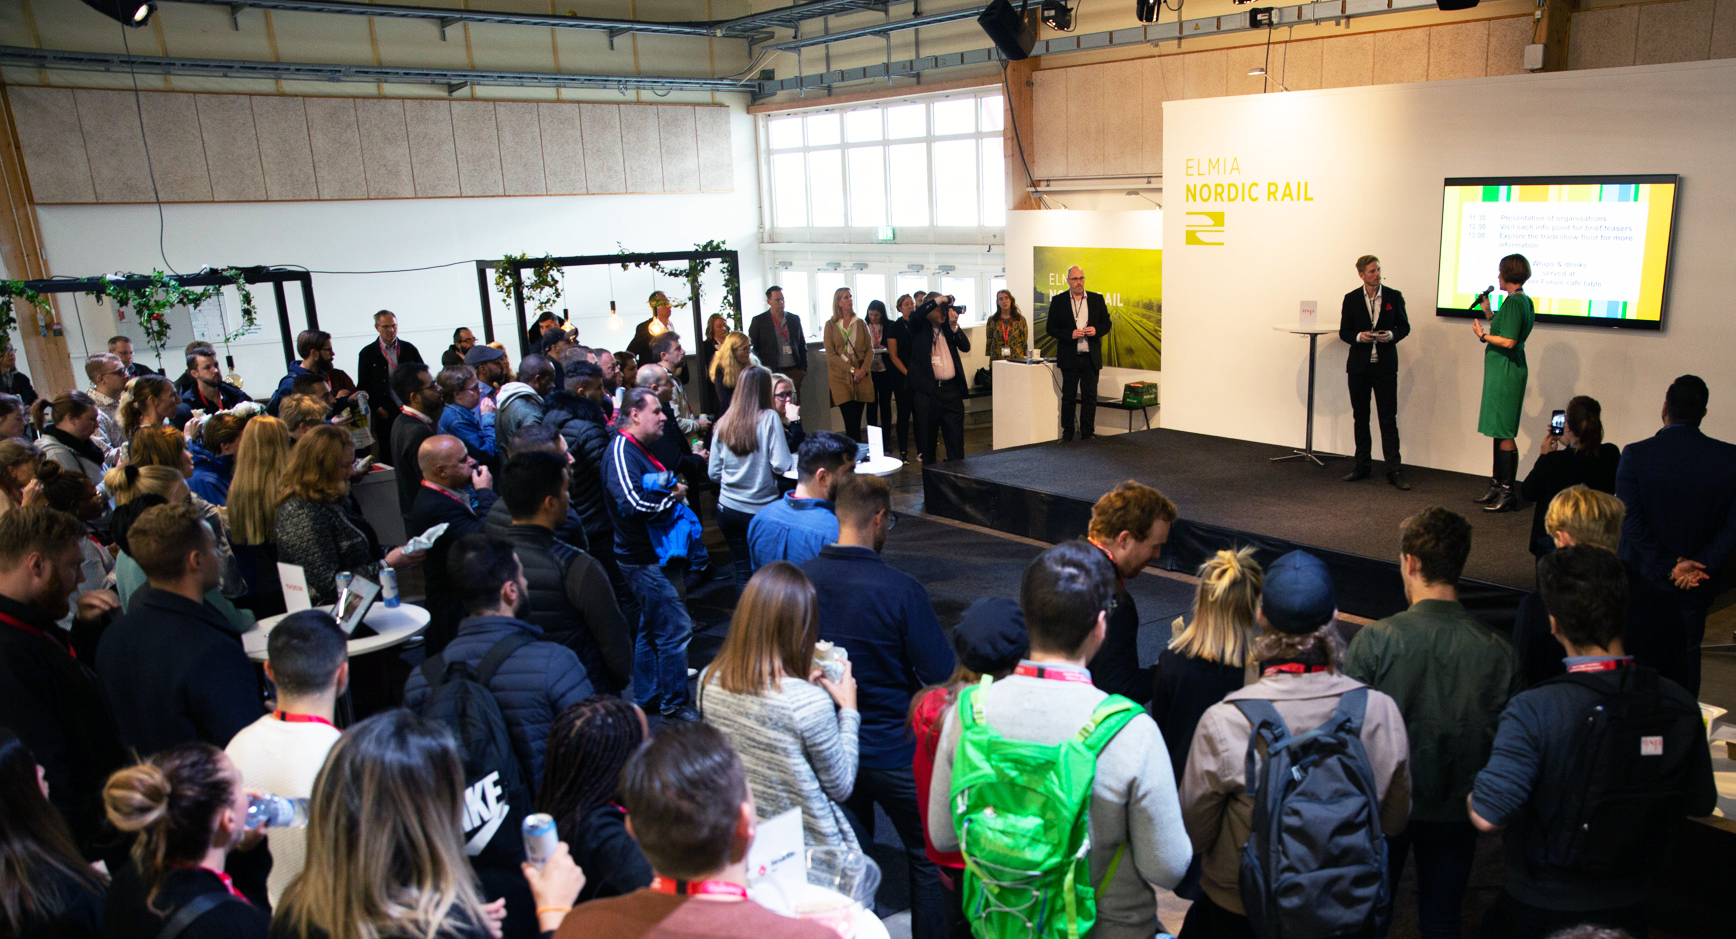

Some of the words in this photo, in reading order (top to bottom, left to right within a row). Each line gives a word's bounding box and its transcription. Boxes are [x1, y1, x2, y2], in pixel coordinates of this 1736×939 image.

[1186, 157, 1241, 176] ELMIA
[1186, 182, 1259, 203] NORDIC
[1267, 181, 1314, 202] RAIL
